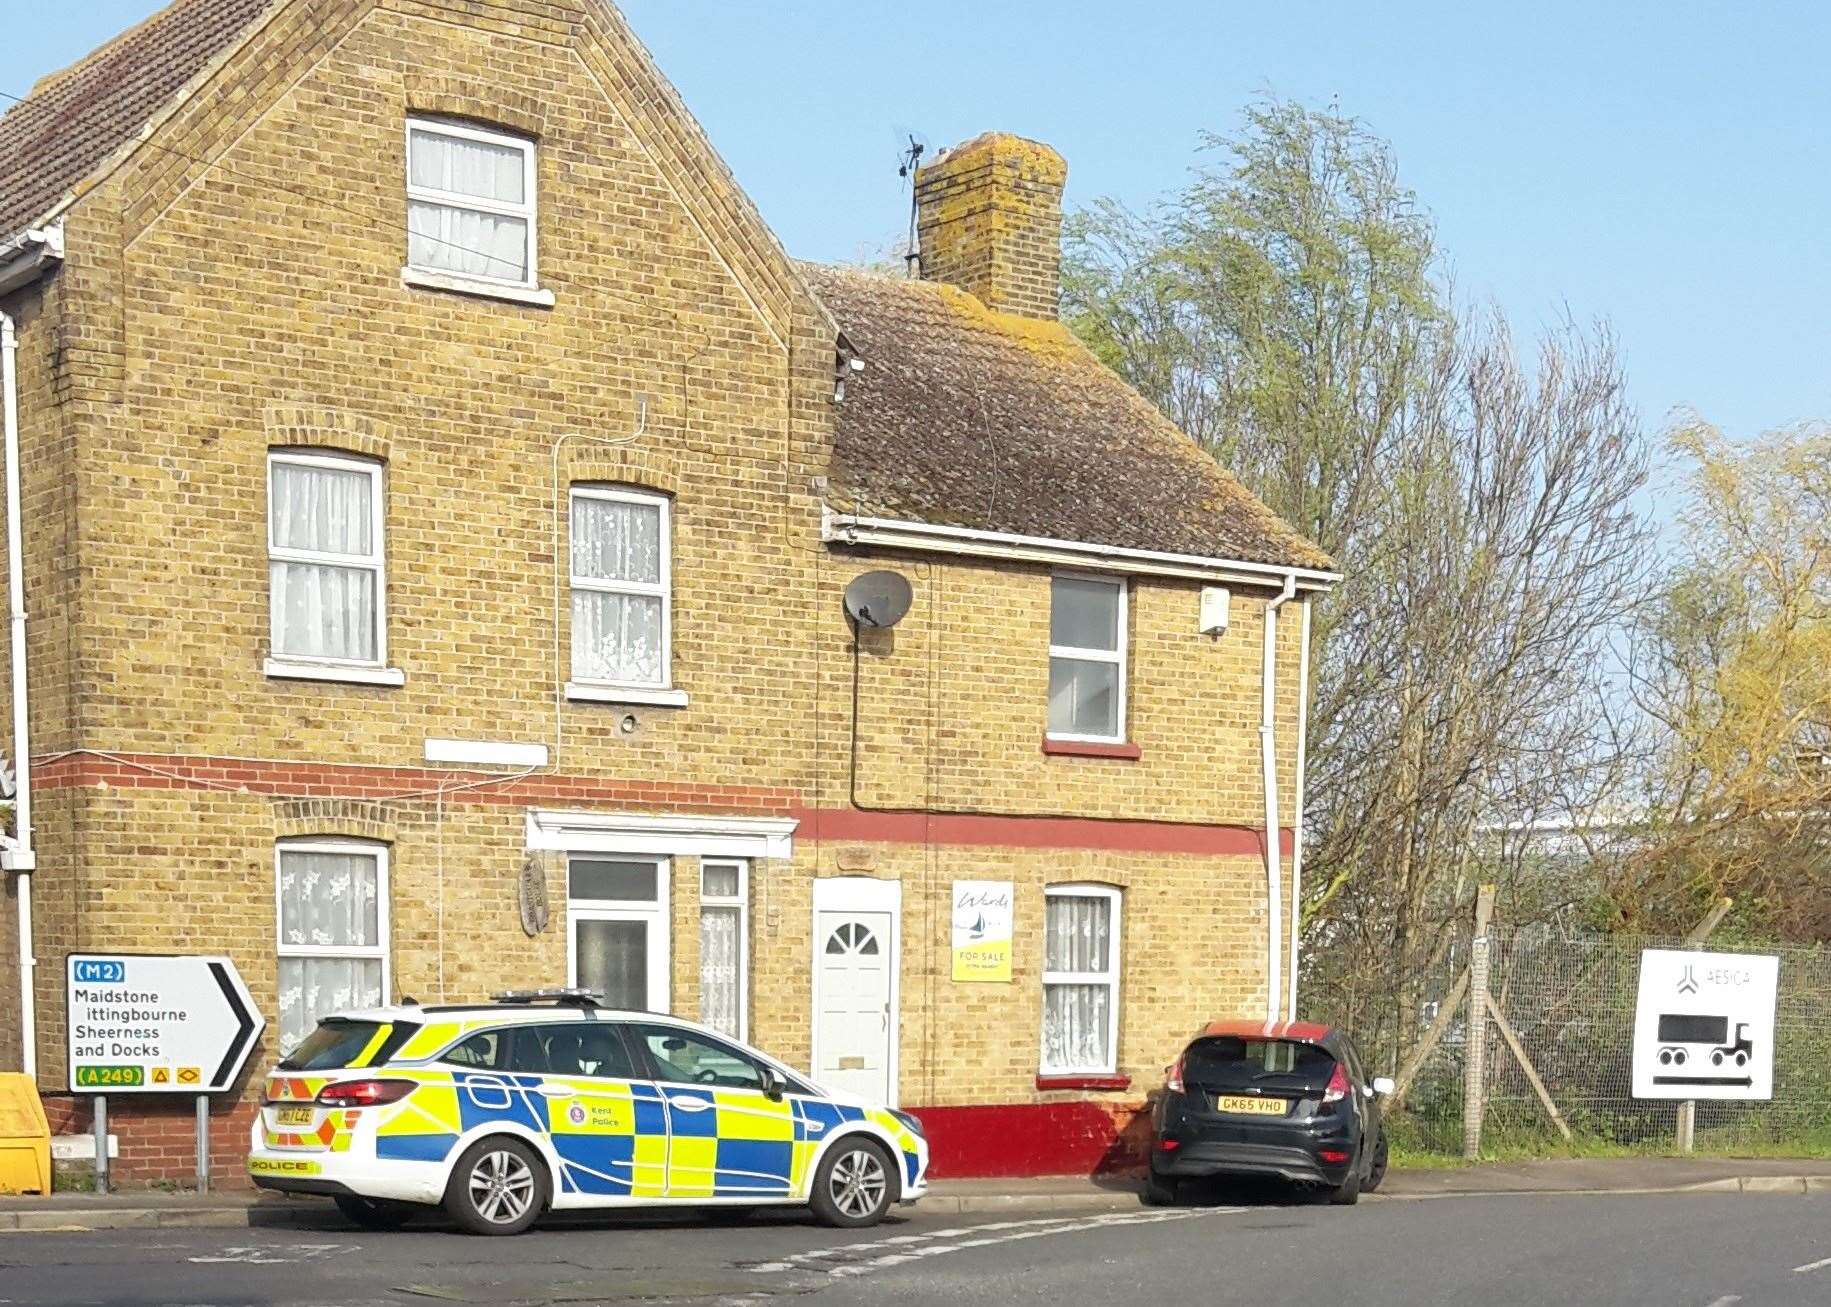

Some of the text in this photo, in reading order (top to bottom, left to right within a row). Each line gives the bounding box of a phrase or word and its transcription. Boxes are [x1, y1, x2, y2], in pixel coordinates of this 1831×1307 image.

[960, 952, 1005, 961] FOR SALE
[76, 962, 123, 980] (M2)
[1706, 969, 1750, 985] AESICA
[75, 989, 159, 1003] Maidstone
[87, 1007, 187, 1023] ittingbourne
[75, 1025, 160, 1039] Sheerness
[75, 1043, 160, 1057] and Docks
[592, 1117, 618, 1126] Police
[252, 1161, 308, 1170] POLICE
